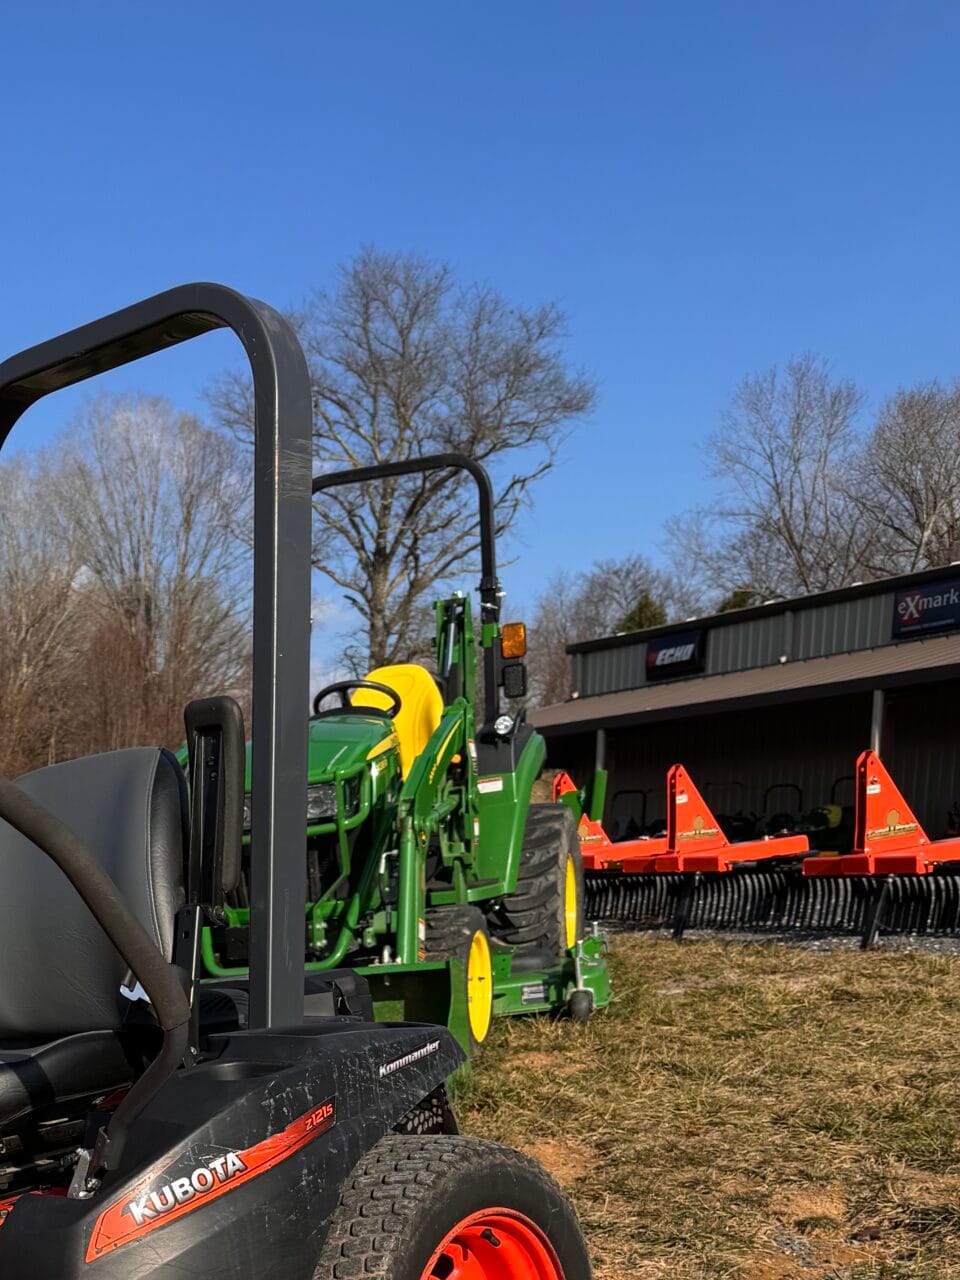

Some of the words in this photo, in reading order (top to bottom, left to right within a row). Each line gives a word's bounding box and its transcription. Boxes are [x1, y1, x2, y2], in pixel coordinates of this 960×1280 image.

[655, 643, 695, 666] ECHO
[379, 1040, 440, 1078] Kommander
[128, 1151, 247, 1226] KUBOTA
